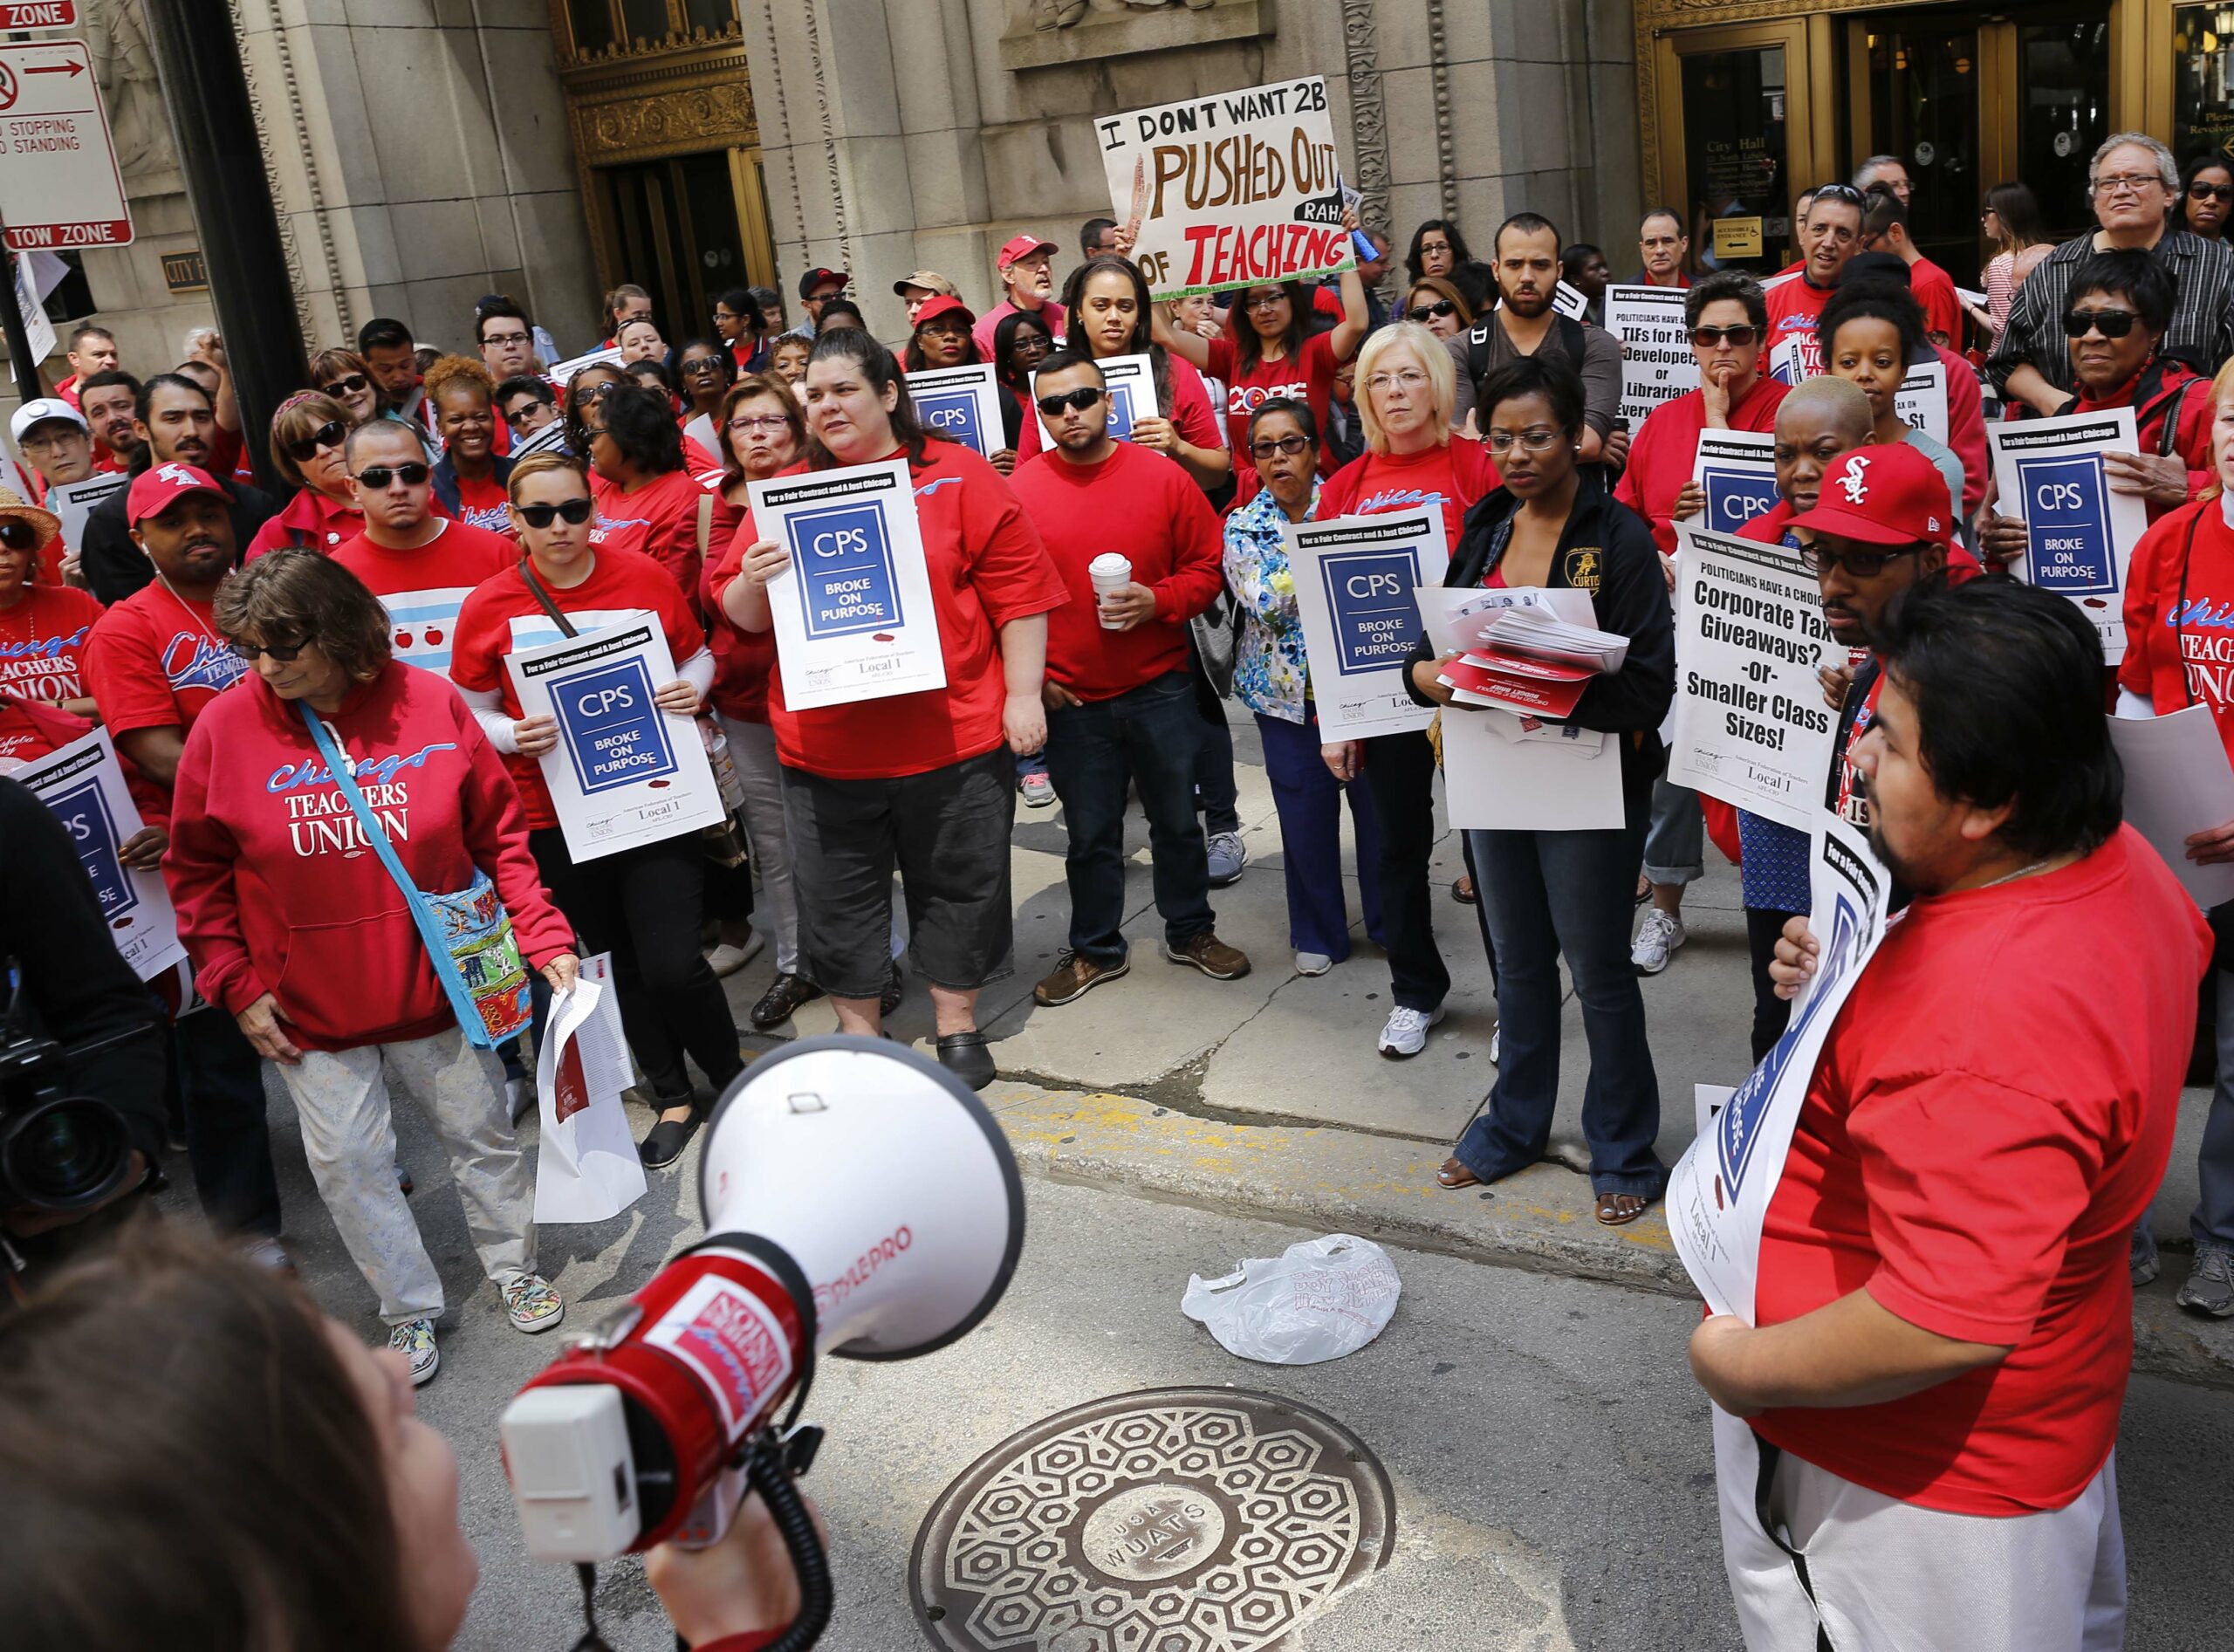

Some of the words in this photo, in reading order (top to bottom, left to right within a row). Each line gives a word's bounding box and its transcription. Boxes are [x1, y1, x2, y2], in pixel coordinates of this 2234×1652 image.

[7, 3, 66, 26] ZONE
[10, 119, 76, 136] STOPPING
[1100, 120, 1126, 151] I
[1223, 88, 1289, 125] WANT
[1294, 81, 1326, 114] 2B
[2189, 124, 2234, 134] Revolvin
[0, 141, 7, 154] O
[14, 136, 80, 154] STANDING
[1706, 141, 1732, 153] City
[1739, 137, 1765, 150] Hall
[1149, 134, 1286, 221] PUSHED
[1291, 127, 1336, 195] OUT
[1304, 202, 1342, 222] RAH
[10, 227, 52, 247] TOW
[59, 223, 116, 244] ZONE
[1184, 223, 1348, 286] TEACHING
[165, 259, 194, 284] CITY
[1137, 250, 1170, 286] OF
[1616, 313, 1661, 323] POLITICIANS
[1662, 315, 1679, 324] HAVE
[1621, 327, 1649, 342] TIFs
[1653, 328, 1672, 344] for
[1675, 330, 1689, 344] Ri
[1655, 369, 1669, 380] or
[1229, 382, 1307, 412] CORE
[1627, 382, 1689, 400] Librarian
[1896, 401, 1906, 410] AX
[1908, 401, 1917, 409] ON
[929, 408, 968, 428] CPS
[2066, 431, 2082, 442] Just
[2082, 427, 2115, 439] Chicago
[767, 494, 779, 504] For
[785, 490, 798, 501] Fair
[798, 487, 829, 499] Contract
[829, 483, 843, 495] and
[842, 483, 848, 492] A
[848, 481, 863, 491] Just
[863, 477, 893, 489] Chicago
[2037, 482, 2083, 511] CPS
[1723, 494, 1770, 520] CPS
[812, 527, 869, 559] CPS
[1301, 536, 1314, 545] For
[1319, 534, 1333, 544] Fair
[1333, 531, 1364, 542] Contract
[1363, 530, 1377, 539] and
[1377, 529, 1383, 538] A
[1382, 528, 1398, 538] Just
[1397, 524, 1427, 536] Chicago
[2044, 538, 2084, 552] BROKE
[1695, 538, 1707, 547] For
[1712, 541, 1727, 552] Fair
[1727, 545, 1759, 560] Contract
[1758, 554, 1774, 565] and
[1781, 559, 1796, 570] Just
[2054, 552, 2073, 565] ON
[2040, 566, 2097, 579] PURPOSE
[825, 578, 873, 596] BROKE
[1347, 572, 1401, 600] CPS
[1701, 562, 1758, 588] POLITICIANS
[1759, 579, 1783, 596] HAVE
[1785, 586, 1792, 599] A
[1793, 588, 1824, 607] CHOIC
[839, 592, 862, 607] ON
[821, 602, 885, 622] PURPOSE
[1694, 579, 1795, 631] Corporate
[1799, 609, 1833, 644] Tax
[1357, 618, 1404, 634] BROKE
[1371, 631, 1395, 643] ON
[0, 626, 89, 658] icago
[1700, 614, 1822, 668] Giveaways?
[526, 665, 538, 675] For
[538, 662, 545, 671] a
[545, 659, 559, 669] Fair
[558, 651, 589, 666] Contract
[589, 647, 602, 657] and
[602, 643, 609, 653] A
[622, 631, 649, 646] Chicago
[0, 655, 78, 682] ACHERS
[859, 659, 892, 674] Local
[895, 658, 901, 668] 1
[1741, 661, 1778, 684] -or-
[0, 674, 83, 701] NION
[578, 683, 635, 718] CPS
[1340, 698, 1374, 709] Chicago
[1392, 696, 1415, 709] Loc
[1687, 671, 1769, 715] Smaller
[1771, 695, 1829, 734] Class
[594, 729, 642, 751] BROKE
[1725, 712, 1785, 751] Sizes!
[609, 744, 634, 759] ON
[1694, 748, 1732, 760] Chicago
[266, 742, 457, 793] Chiago
[593, 751, 657, 776] PURPOSE
[1748, 766, 1782, 789] Local
[1785, 780, 1791, 792] 1
[284, 781, 408, 819] TEACERS
[639, 803, 671, 820] Local
[675, 801, 681, 811] 1
[1827, 842, 1841, 865] For
[1840, 853, 1847, 869] a
[1846, 857, 1858, 881] Fair
[124, 945, 140, 962] cal
[1689, 1196, 1710, 1247] Local
[831, 1224, 913, 1305] PYLEPRO
